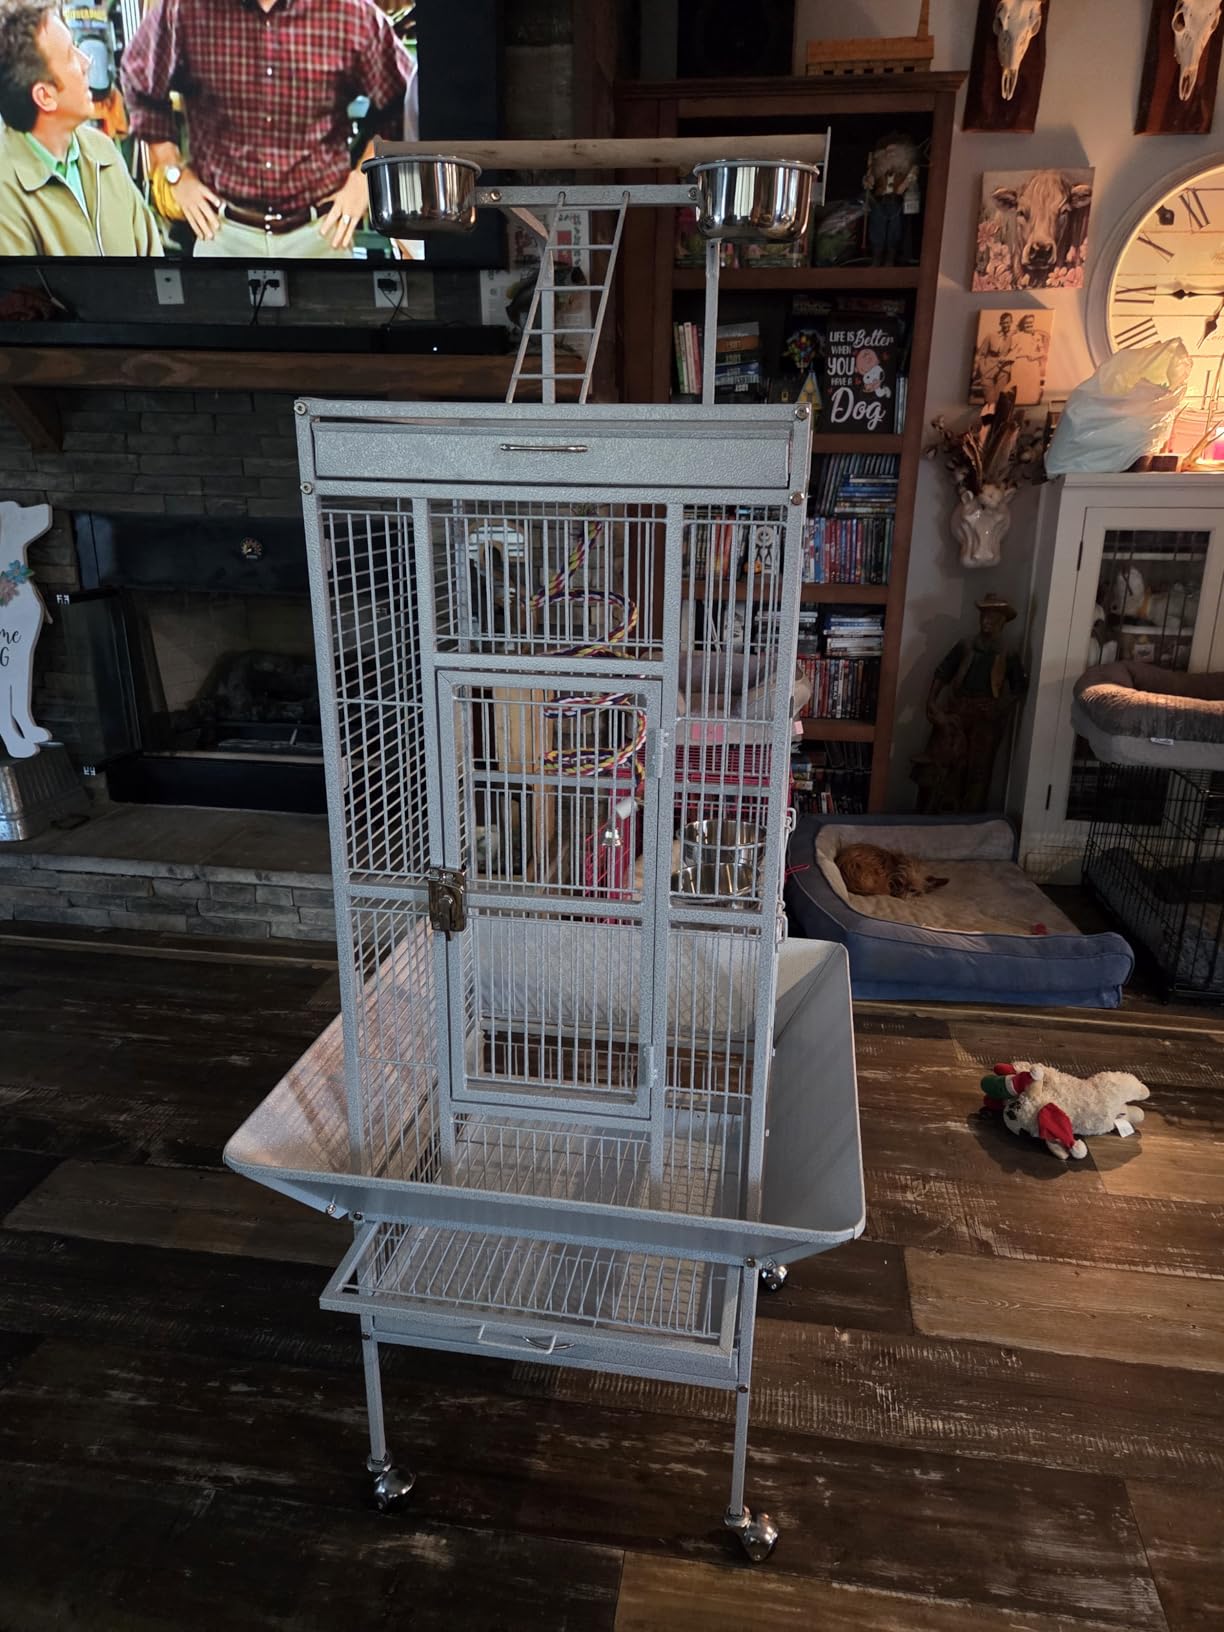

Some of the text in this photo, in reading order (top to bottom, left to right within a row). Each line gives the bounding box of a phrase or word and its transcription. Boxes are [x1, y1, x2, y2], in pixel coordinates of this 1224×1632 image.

[829, 329, 894, 349] LIFE IS Better
[831, 345, 852, 355] WHEN
[827, 356, 855, 376] YOU
[831, 377, 853, 386] HAVE A
[831, 386, 887, 430] Dog
